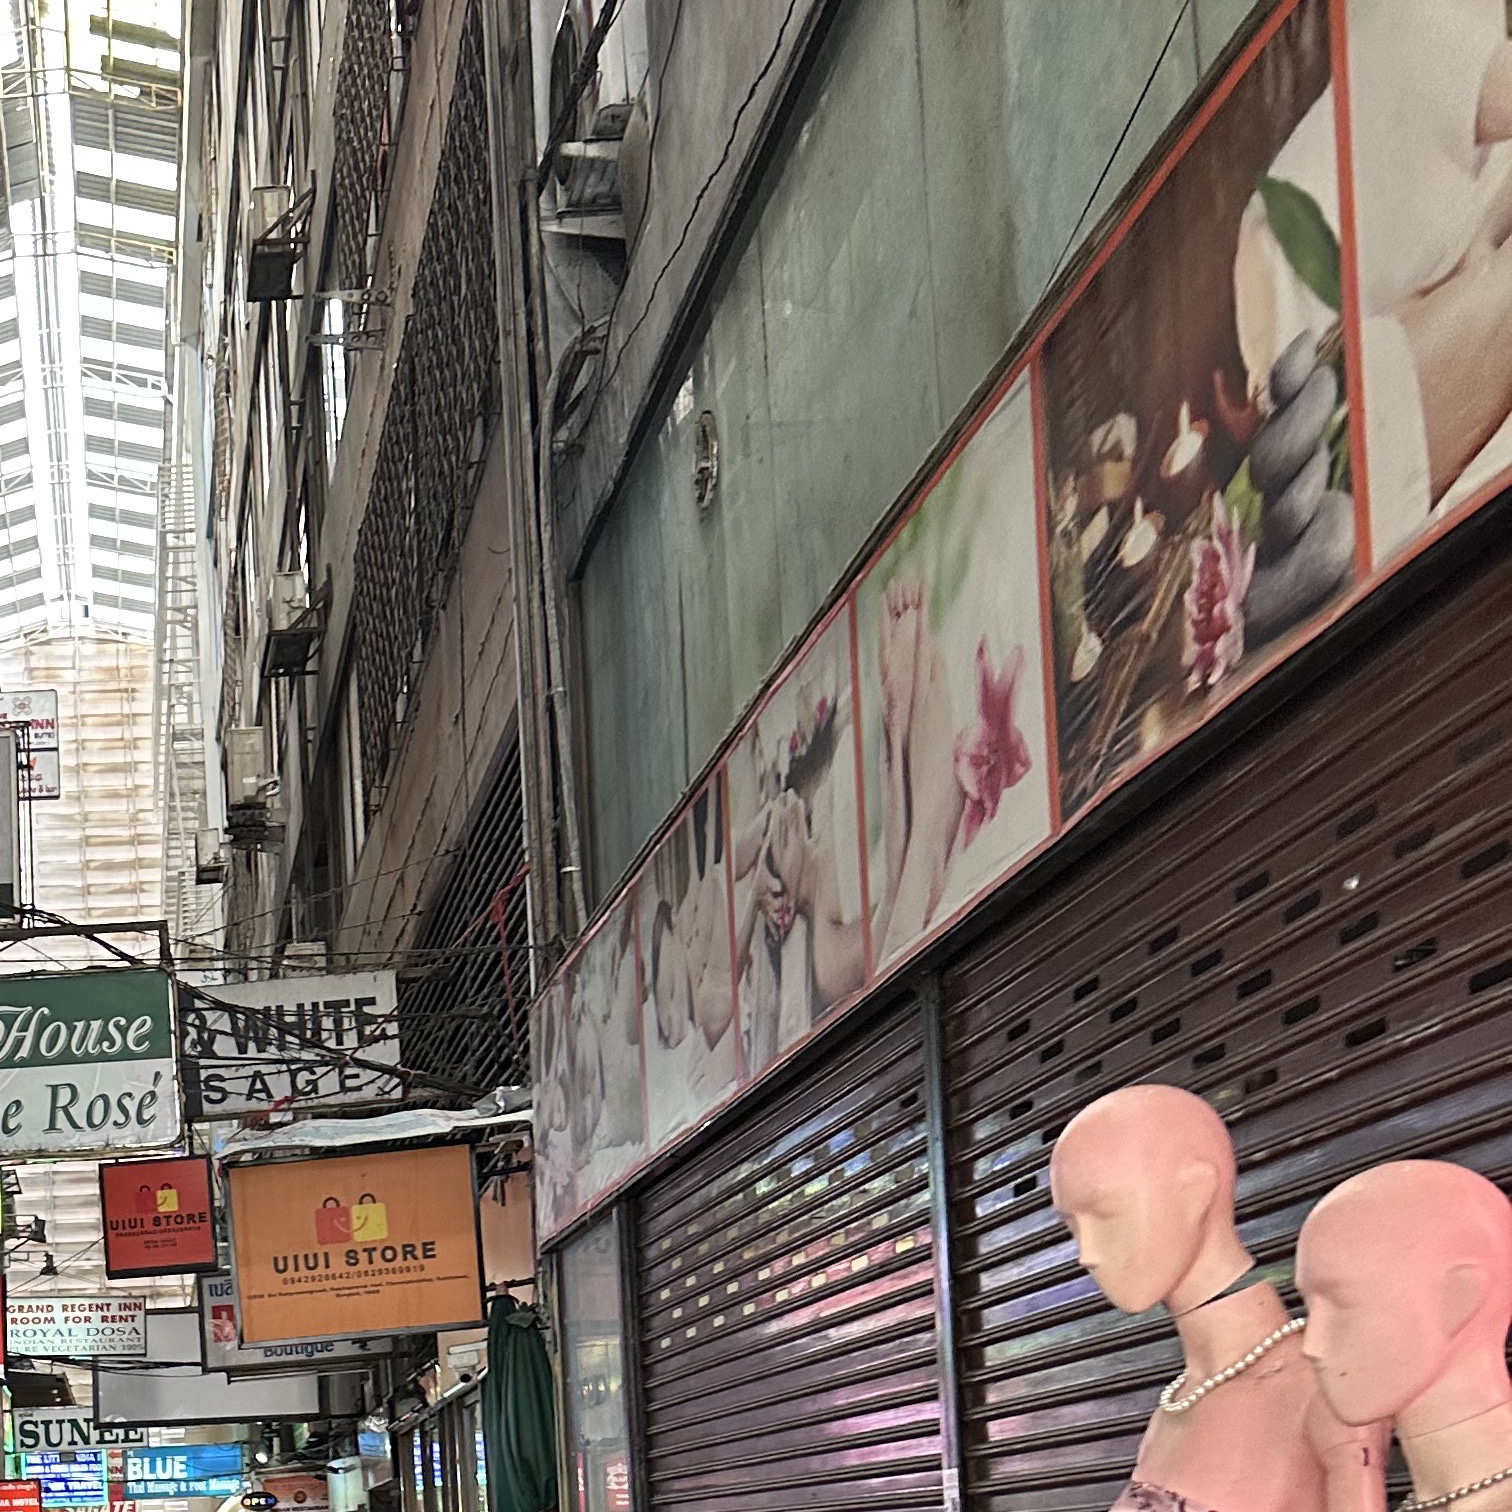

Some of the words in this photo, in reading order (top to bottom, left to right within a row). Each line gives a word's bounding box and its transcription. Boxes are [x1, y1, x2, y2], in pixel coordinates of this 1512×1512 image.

[229, 996, 377, 1055] WHITE
[43, 1072, 163, 1135] Rosé
[110, 1218, 145, 1231] UIUI
[152, 1211, 208, 1228] STORE
[273, 1251, 330, 1275] UIUI
[345, 1241, 437, 1267] STORE
[7, 1305, 55, 1315] GRAND
[61, 1303, 112, 1313] REGENT
[118, 1302, 143, 1312] INN
[10, 1316, 56, 1326] ROOM
[64, 1315, 93, 1325] FOR
[100, 1314, 138, 1324] RENT
[10, 1327, 79, 1339] ROYAL
[86, 1327, 142, 1337] DOSA
[19, 1418, 144, 1449] SUNEE
[127, 1455, 188, 1480] BLUE
